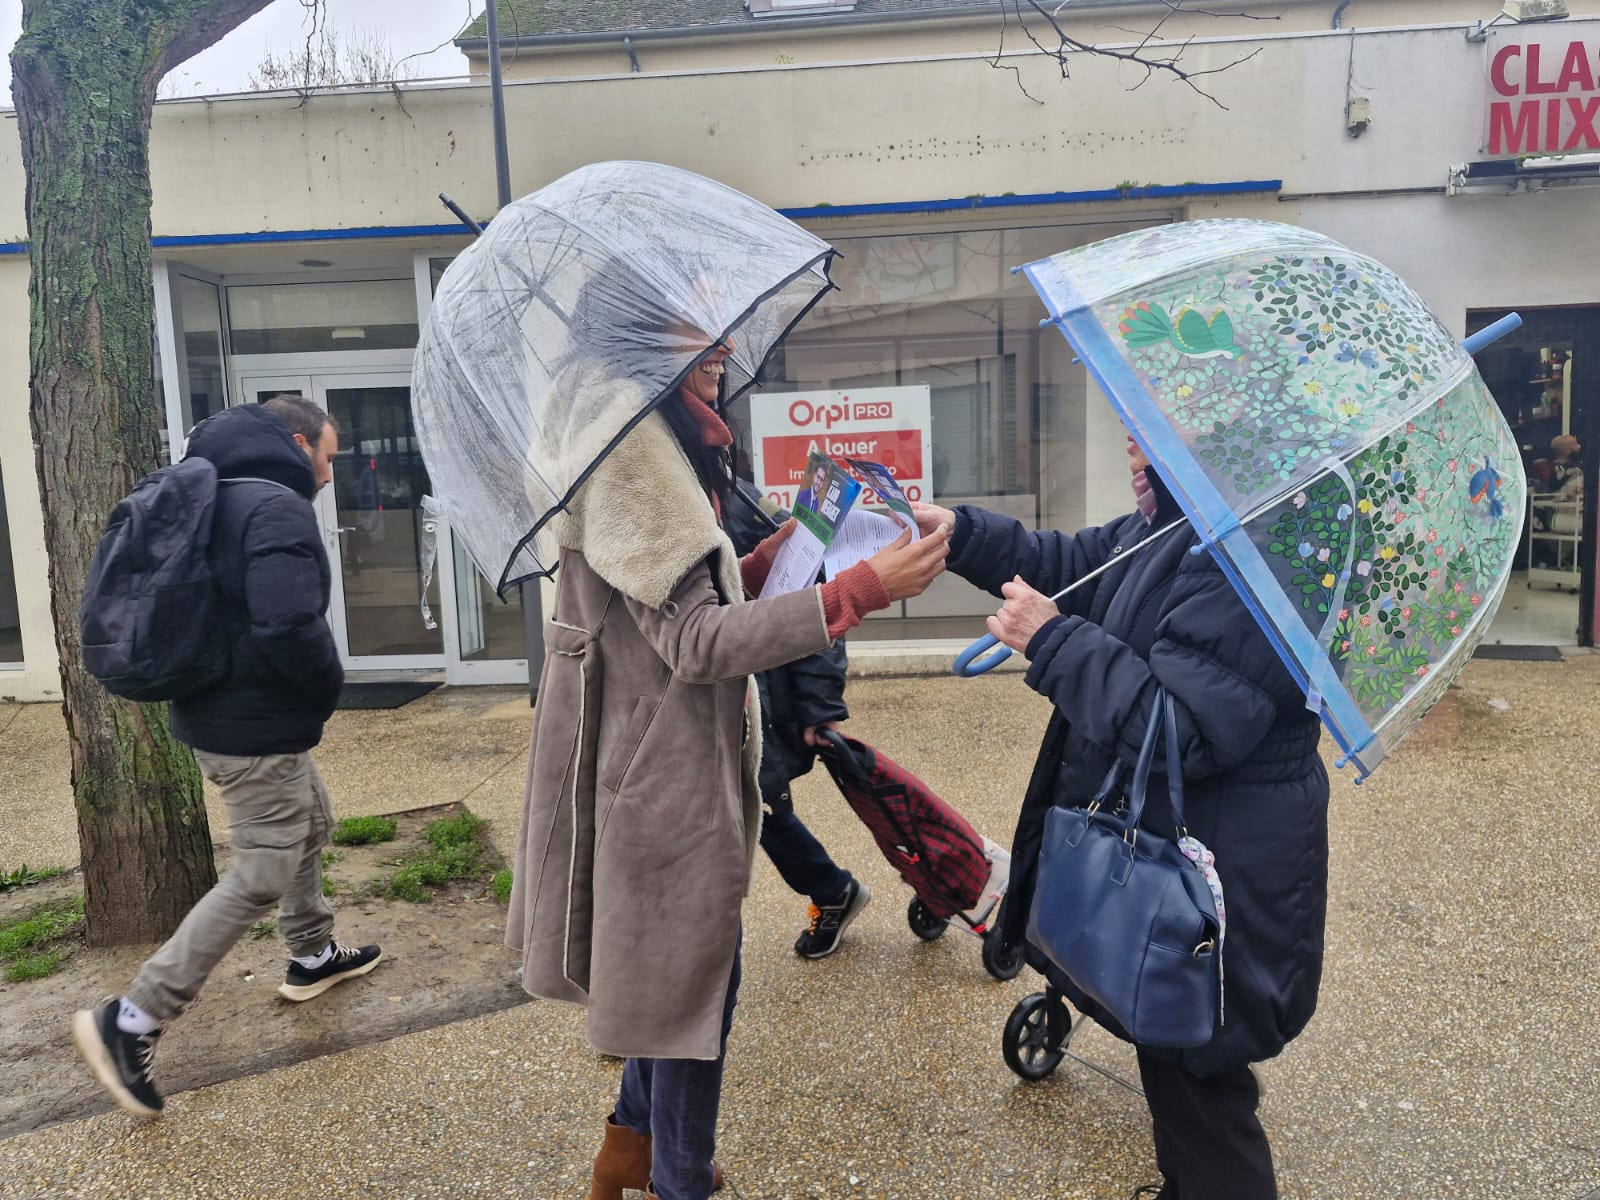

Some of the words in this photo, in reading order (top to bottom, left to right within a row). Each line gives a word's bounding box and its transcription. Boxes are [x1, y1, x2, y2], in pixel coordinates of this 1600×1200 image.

[1491, 41, 1600, 96] CLA
[789, 396, 849, 429] Orpi
[856, 404, 890, 418] PRO
[825, 438, 877, 456] louer
[767, 491, 791, 508] 01
